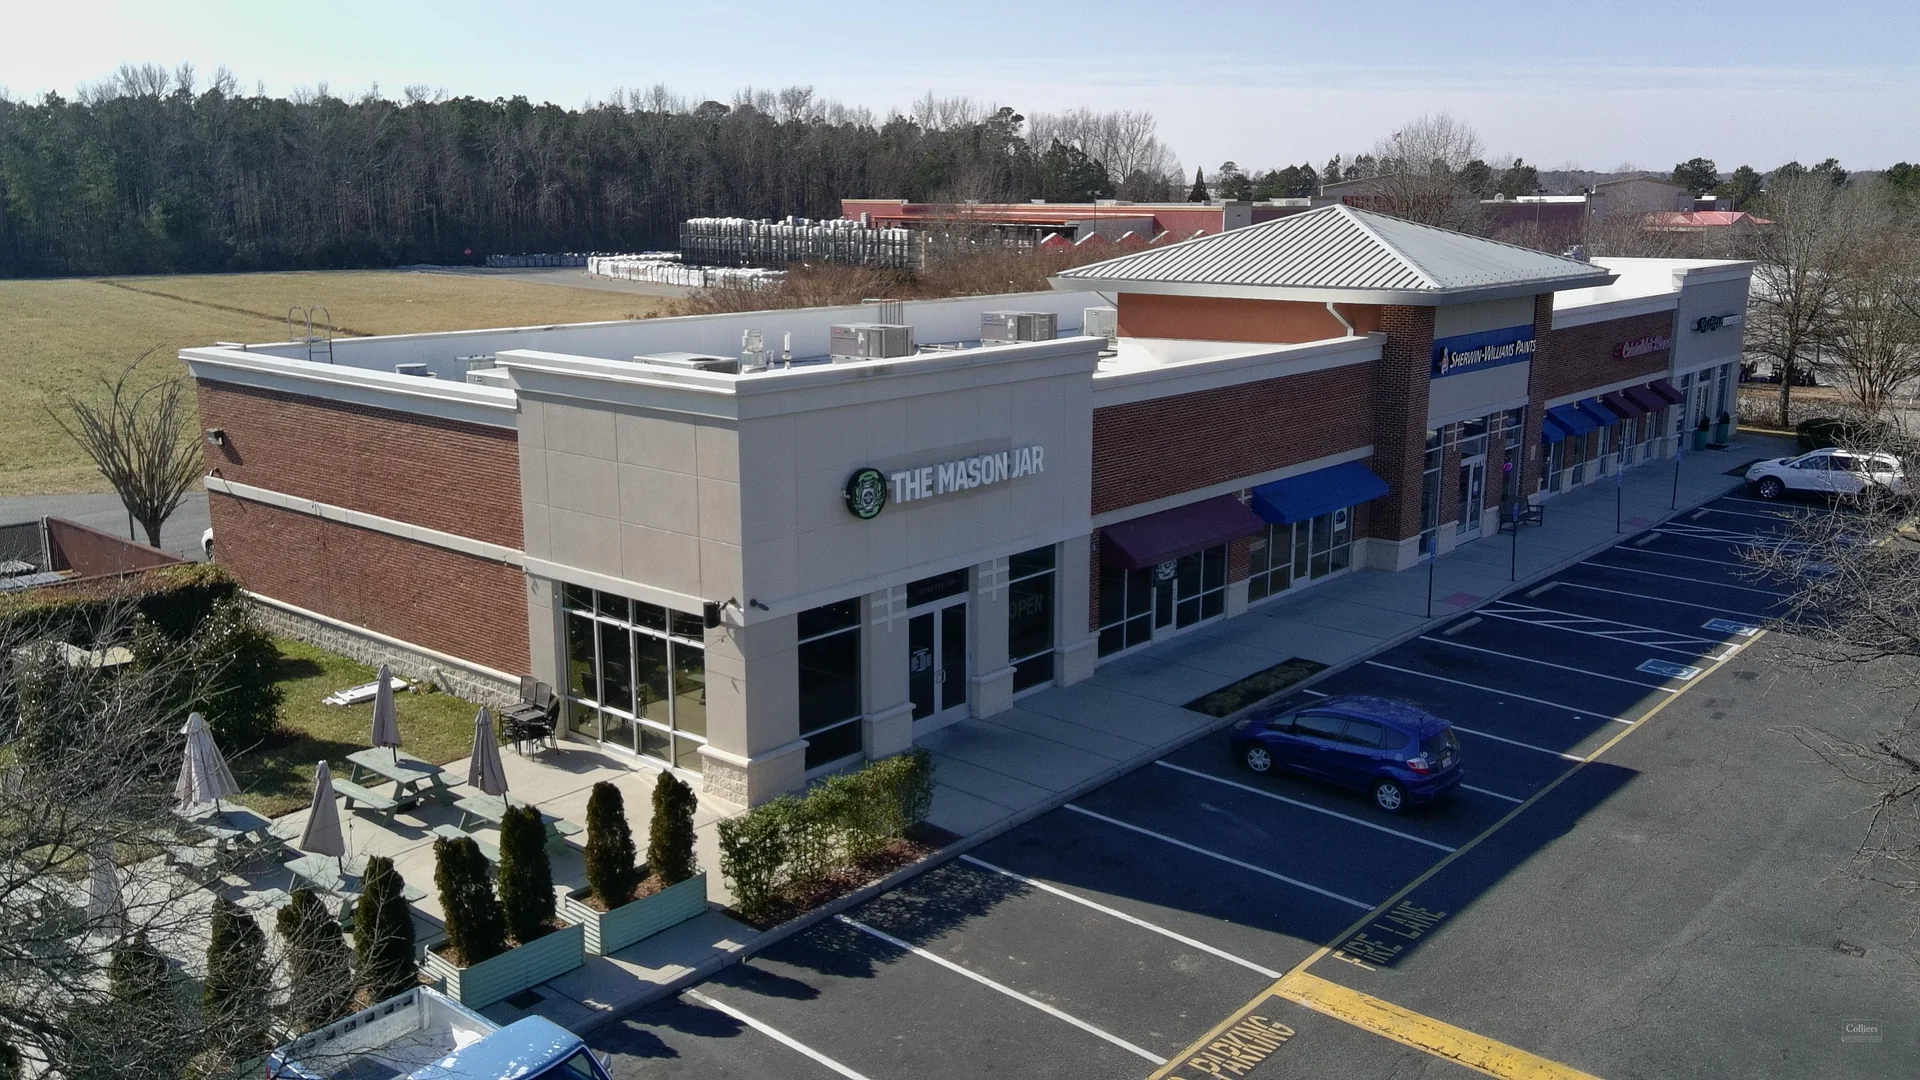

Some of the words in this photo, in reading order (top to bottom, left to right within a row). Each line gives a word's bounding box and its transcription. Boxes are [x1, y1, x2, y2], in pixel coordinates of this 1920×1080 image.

[1449, 344, 1515, 369] SHERWIN-WILLIAMS
[1515, 339, 1537, 356] PAINTS
[891, 467, 933, 504] THE
[937, 452, 1008, 494] MASON
[1012, 445, 1045, 479] JAR
[1009, 593, 1043, 619] OPEN
[1332, 933, 1403, 972] FIRE
[1373, 900, 1447, 939] LANE
[1187, 1015, 1296, 1080] PARKING
